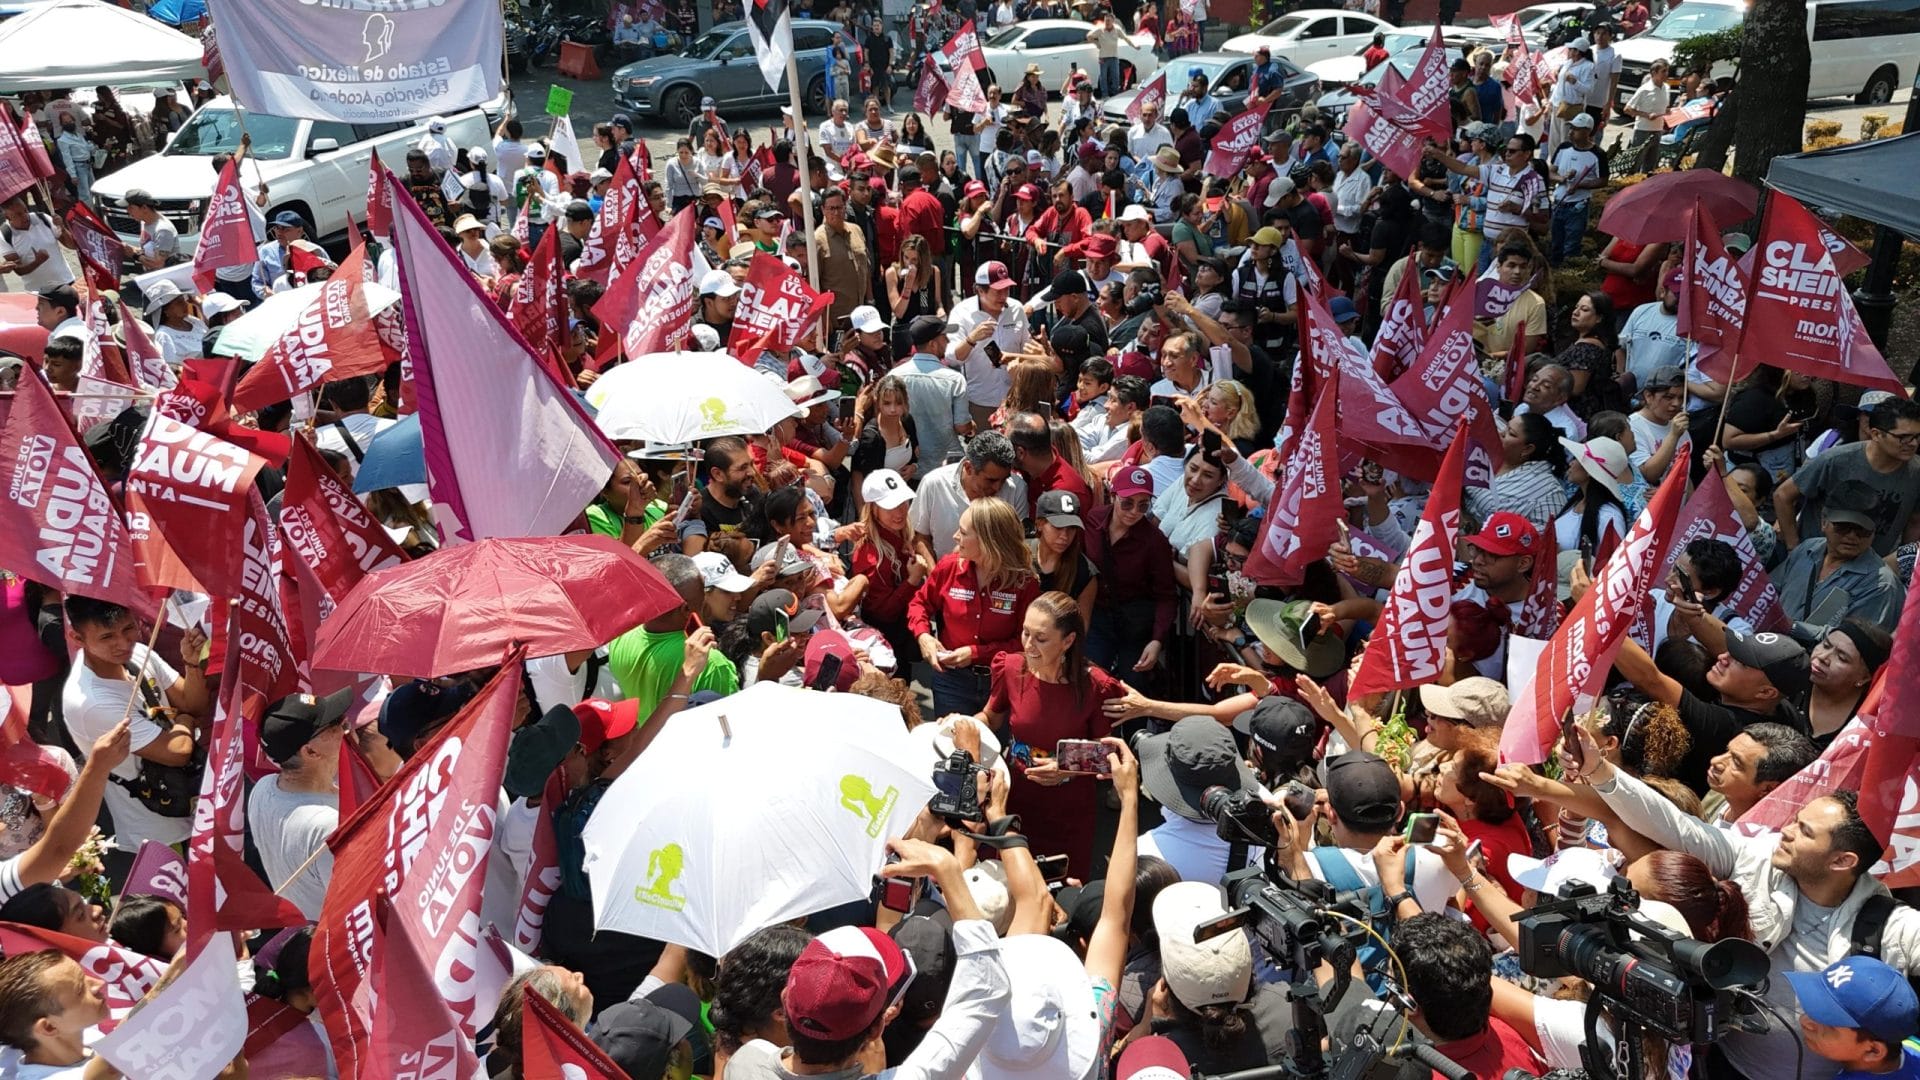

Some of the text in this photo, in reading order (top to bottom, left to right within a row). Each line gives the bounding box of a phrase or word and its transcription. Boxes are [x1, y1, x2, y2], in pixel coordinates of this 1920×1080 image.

[605, 188, 615, 227] VOTA
[326, 279, 345, 328] VOTA
[885, 476, 898, 490] C
[1130, 470, 1146, 485] C
[1316, 458, 1326, 494] JUNIO
[1061, 494, 1074, 512] C
[280, 506, 321, 569] VOTA
[300, 513, 311, 527] DE
[308, 526, 328, 559] JUNIO
[1645, 548, 1656, 569] DE
